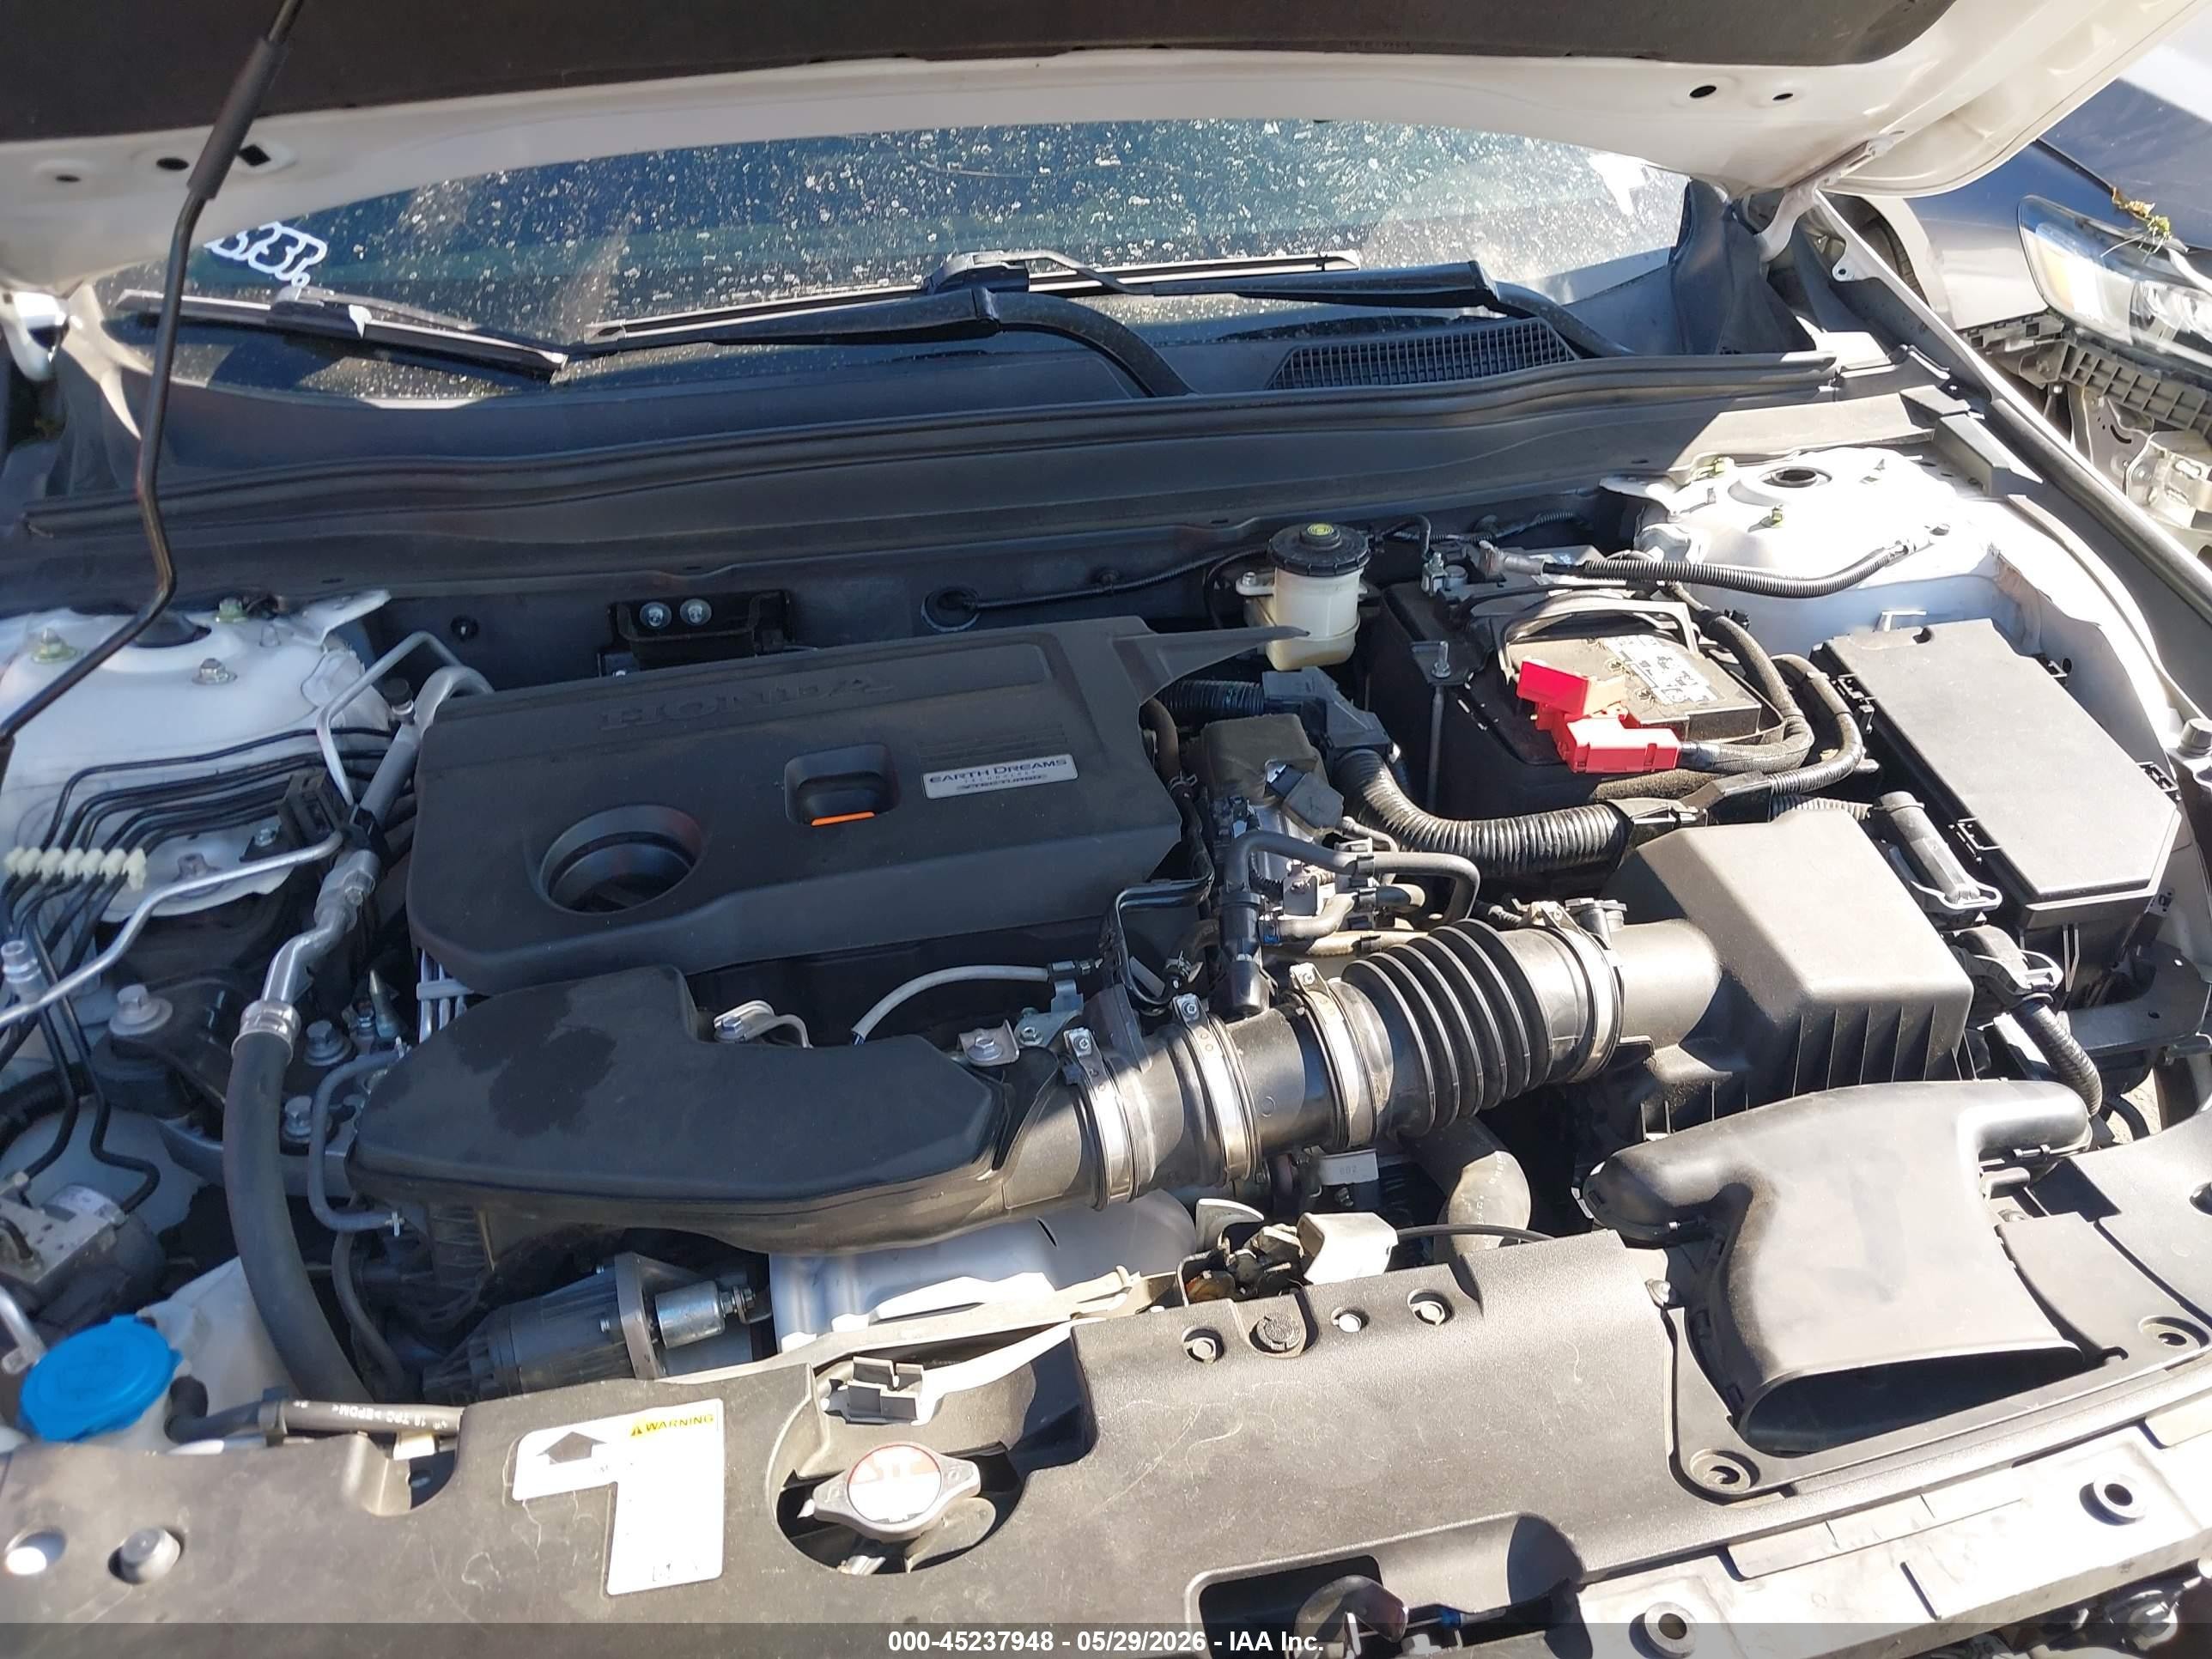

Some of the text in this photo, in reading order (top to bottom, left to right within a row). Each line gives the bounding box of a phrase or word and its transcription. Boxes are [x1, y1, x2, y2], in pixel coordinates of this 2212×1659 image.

[929, 759, 1067, 783] EARTH DREAMS
[646, 1414, 714, 1432] WARNING
